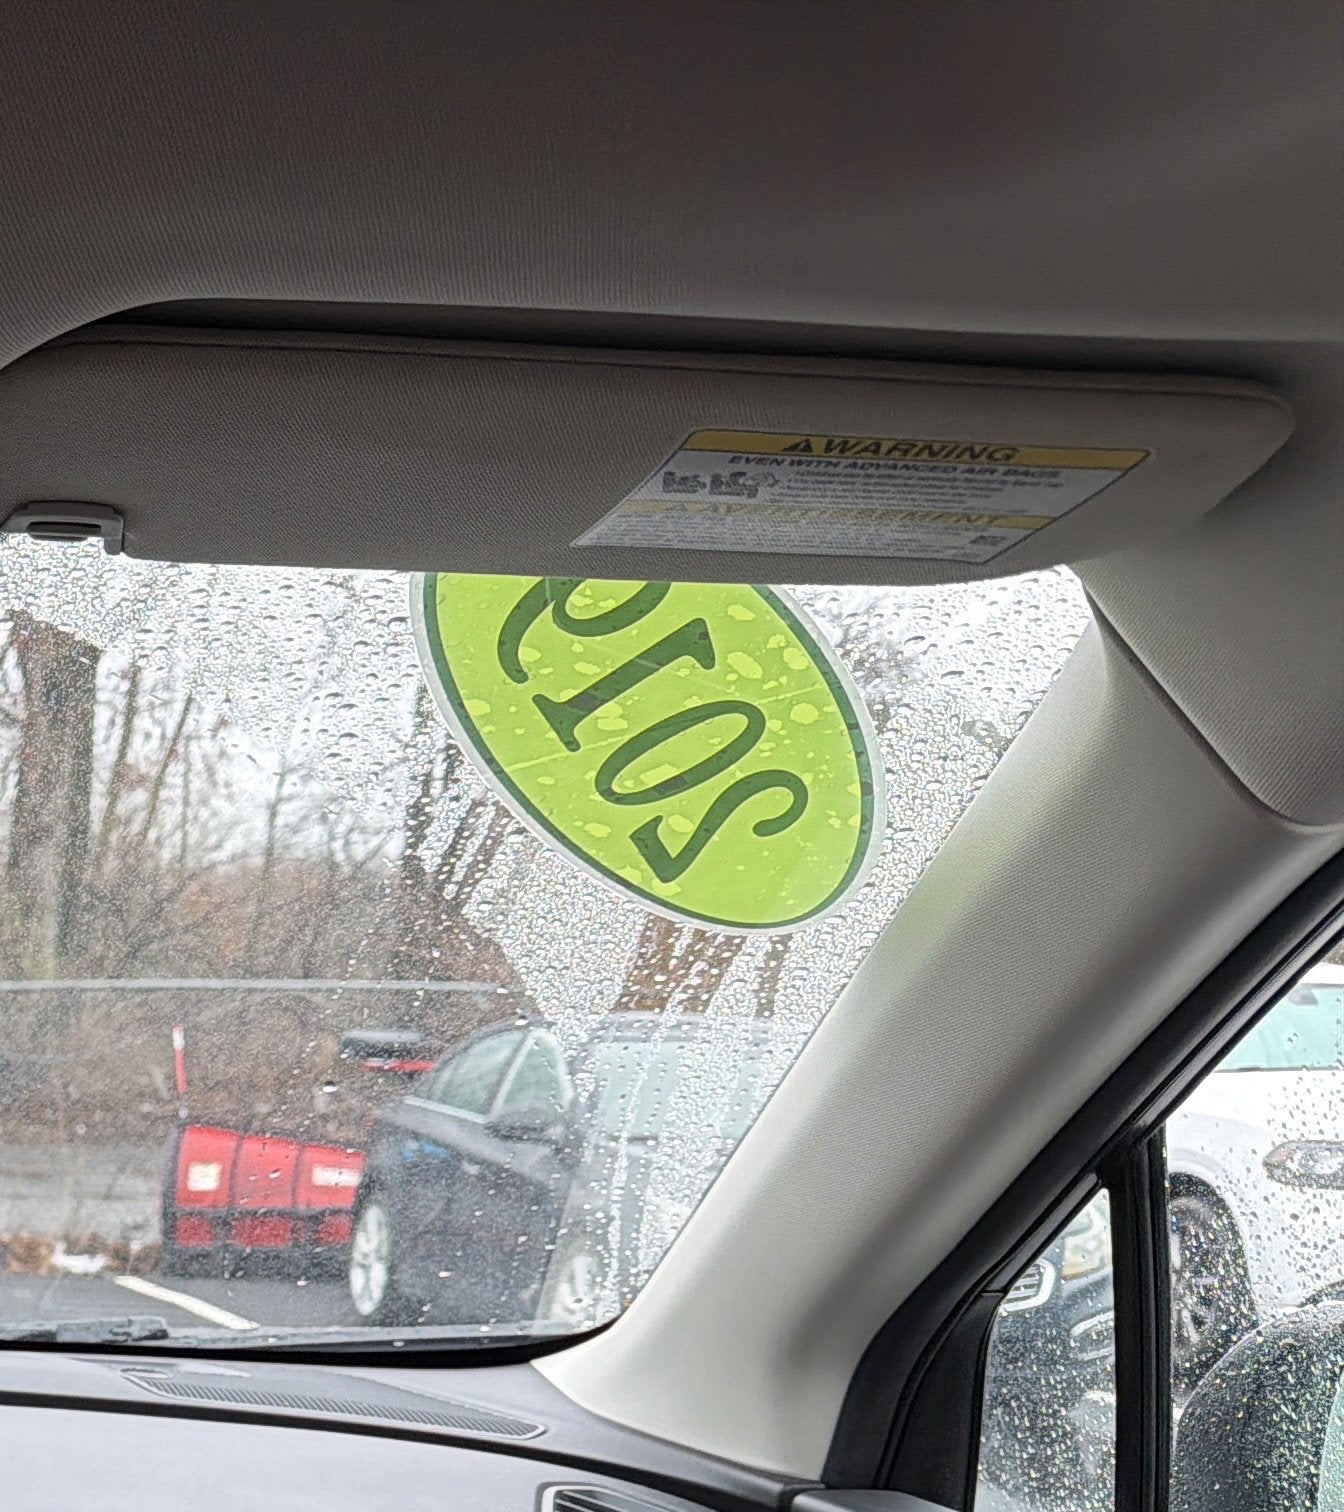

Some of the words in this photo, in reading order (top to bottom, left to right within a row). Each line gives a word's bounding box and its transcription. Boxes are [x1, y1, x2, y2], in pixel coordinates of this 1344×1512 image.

[820, 438, 1018, 463] WARNING
[729, 455, 785, 467] EVEN
[787, 457, 844, 470] WITH
[848, 460, 958, 475] ADVANCED
[962, 465, 995, 477] AIR
[1002, 467, 1059, 479] BAGS
